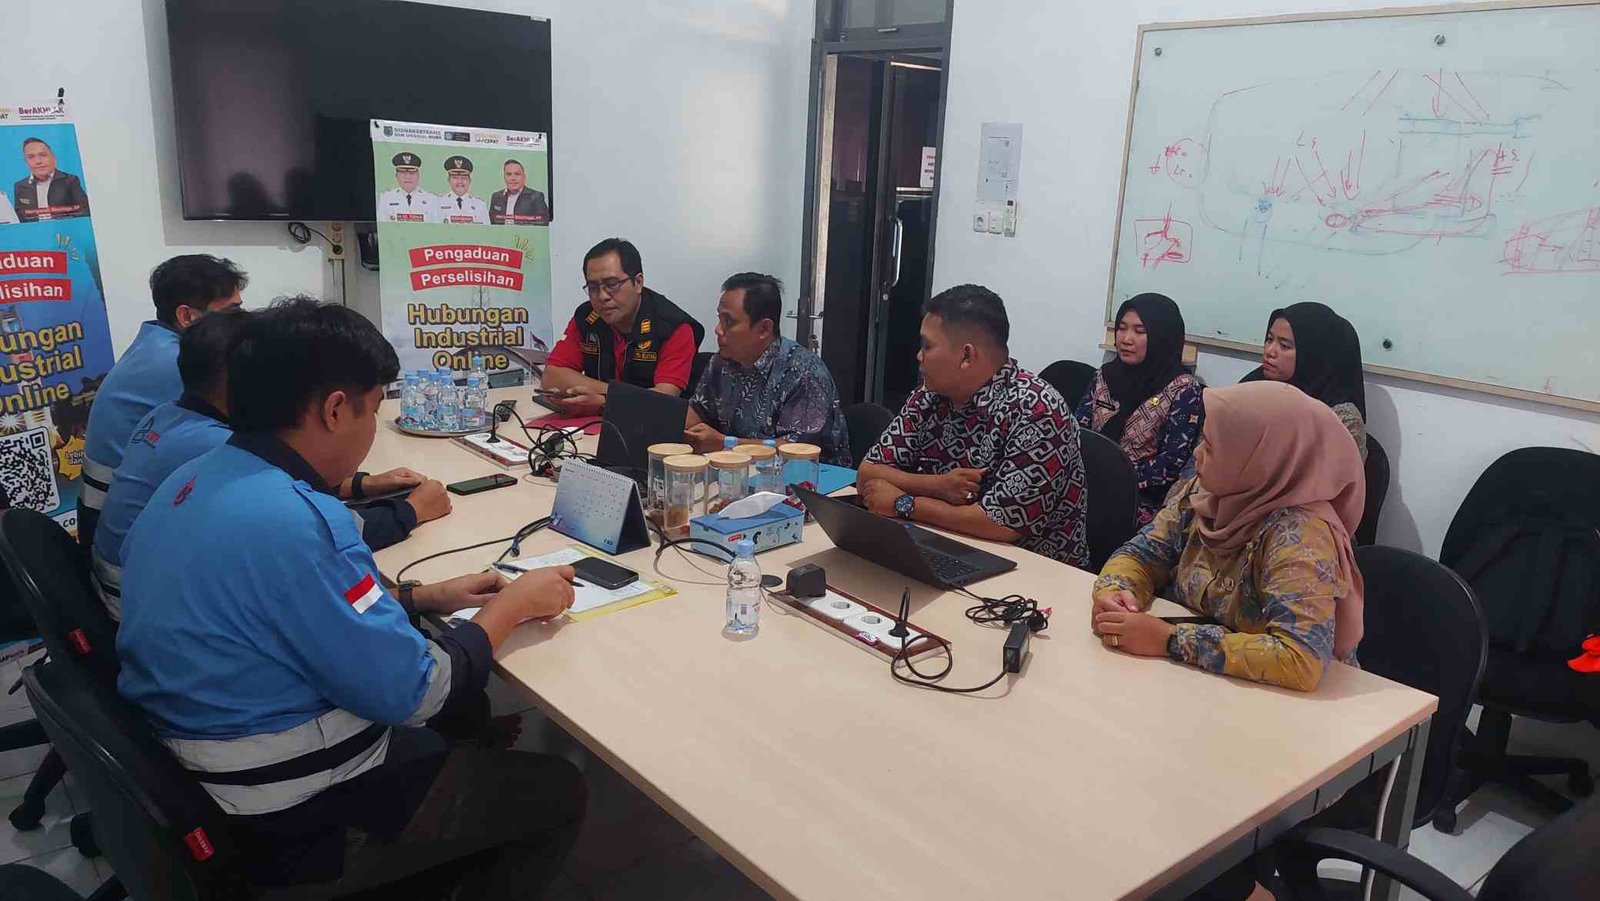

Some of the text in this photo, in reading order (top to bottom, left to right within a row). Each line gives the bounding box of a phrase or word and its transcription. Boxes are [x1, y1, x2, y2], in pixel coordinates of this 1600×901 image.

[424, 248, 509, 263] Pengaduan
[421, 271, 514, 287] Perselisihan
[408, 303, 528, 328] Hubungan
[414, 326, 524, 348] Industrial
[433, 350, 509, 372] Onlne
[0, 382, 70, 415] nline
